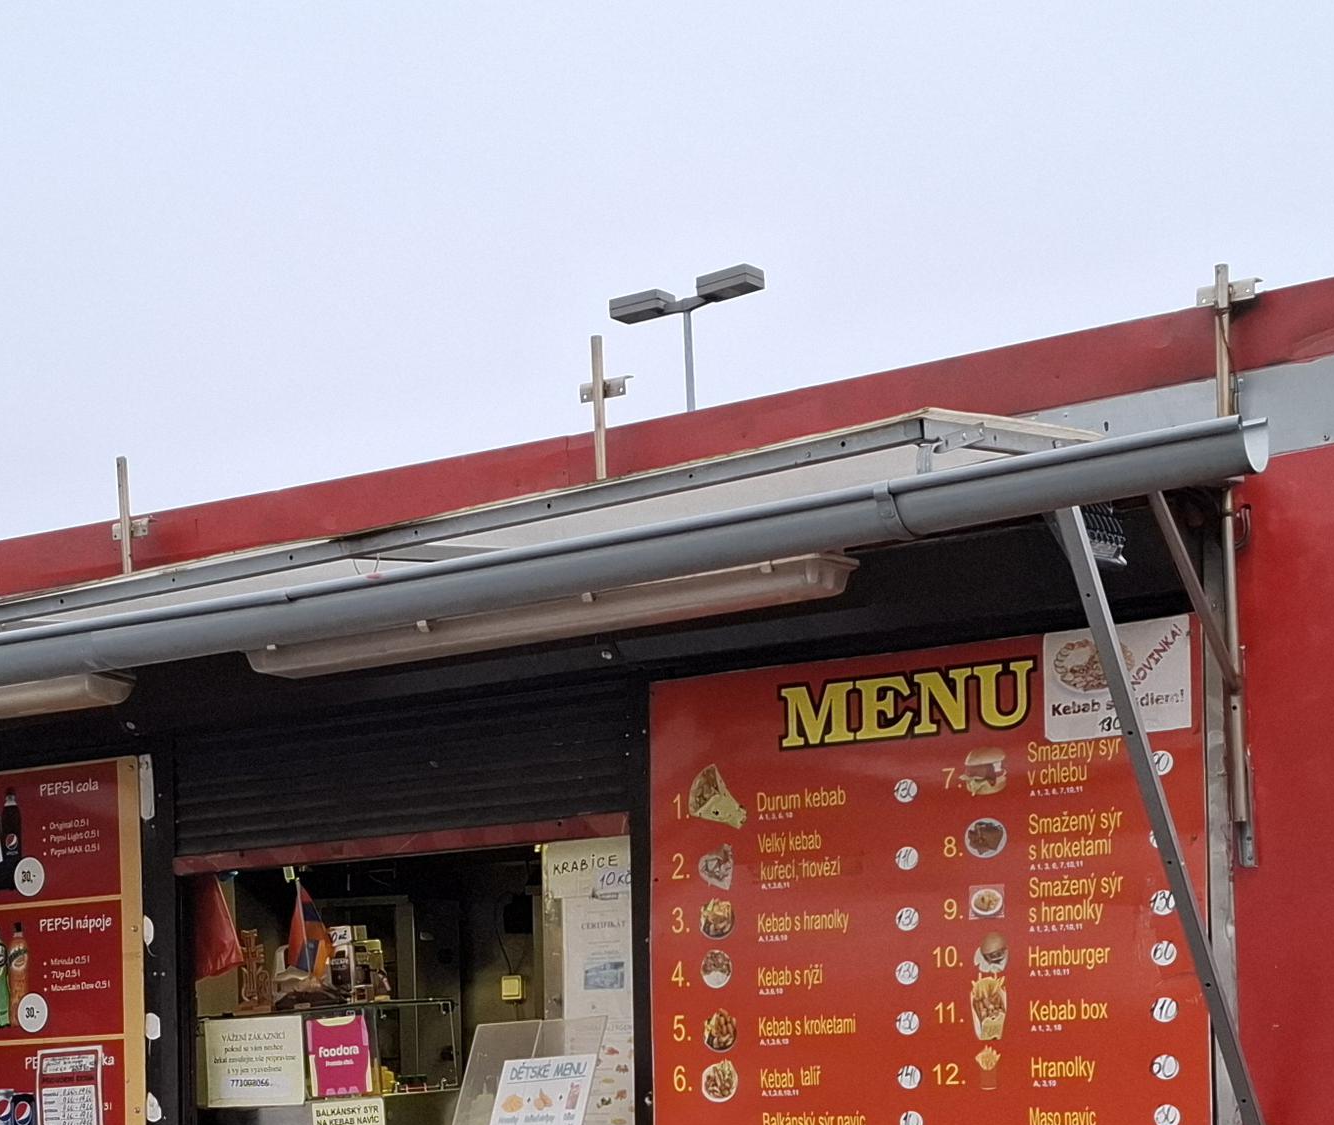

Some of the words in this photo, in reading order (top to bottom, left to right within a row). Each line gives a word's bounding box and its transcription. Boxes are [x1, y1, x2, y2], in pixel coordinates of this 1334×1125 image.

[781, 660, 1033, 747] MENU
[1051, 701, 1101, 717] Kebab
[941, 767, 963, 789] 7.
[1027, 771, 1035, 786] v
[1040, 763, 1087, 785] chlebu
[39, 780, 74, 797] PEPSI
[76, 777, 99, 793] cola
[672, 794, 690, 820] 1.
[757, 791, 801, 813] Durum
[805, 786, 847, 807] kebab
[1028, 808, 1095, 835] Smažený
[1099, 806, 1123, 829] sýr
[67, 845, 82, 854] MAX
[758, 832, 786, 857] Velký
[789, 827, 822, 850] kebab
[943, 836, 964, 857] 8.
[1028, 844, 1037, 860] s
[1040, 836, 1112, 859] kroketami
[671, 853, 691, 880] 2.
[599, 871, 616, 889] 10
[1029, 873, 1096, 899] Smažený
[1101, 871, 1123, 893] sýr
[671, 906, 691, 934] 3.
[757, 913, 792, 934] Kebab
[794, 916, 801, 931] s
[803, 909, 849, 933] hranolky
[944, 899, 964, 920] 9.
[1028, 907, 1037, 923] s
[1041, 899, 1103, 925] hranolky
[39, 916, 74, 932] PEPSI
[76, 914, 112, 934] nápoje
[932, 945, 964, 968] 10.
[1028, 945, 1111, 970] Hamburger
[671, 960, 691, 988] 4.
[757, 966, 792, 987] Kebab
[794, 970, 801, 985] s
[803, 963, 823, 990] rýží
[25, 1006, 40, 1019] 30,-
[934, 1001, 965, 1023] 11.
[1029, 1000, 1075, 1022] Kebab
[1081, 998, 1108, 1020] box
[673, 1015, 692, 1042] 5.
[758, 1015, 792, 1037] Kebab
[795, 1019, 802, 1035] s
[804, 1013, 856, 1036] kroketami
[318, 1045, 360, 1058] foodora
[553, 1061, 588, 1078] MENU
[673, 1065, 693, 1092] 6.
[760, 1067, 795, 1089] Kebab
[800, 1065, 822, 1087] talíř
[932, 1063, 966, 1085] 12.
[1030, 1056, 1096, 1082] Hranolky
[316, 1105, 361, 1118] BALKÁNSKÝ
[356, 1114, 380, 1125] NAVÍC
